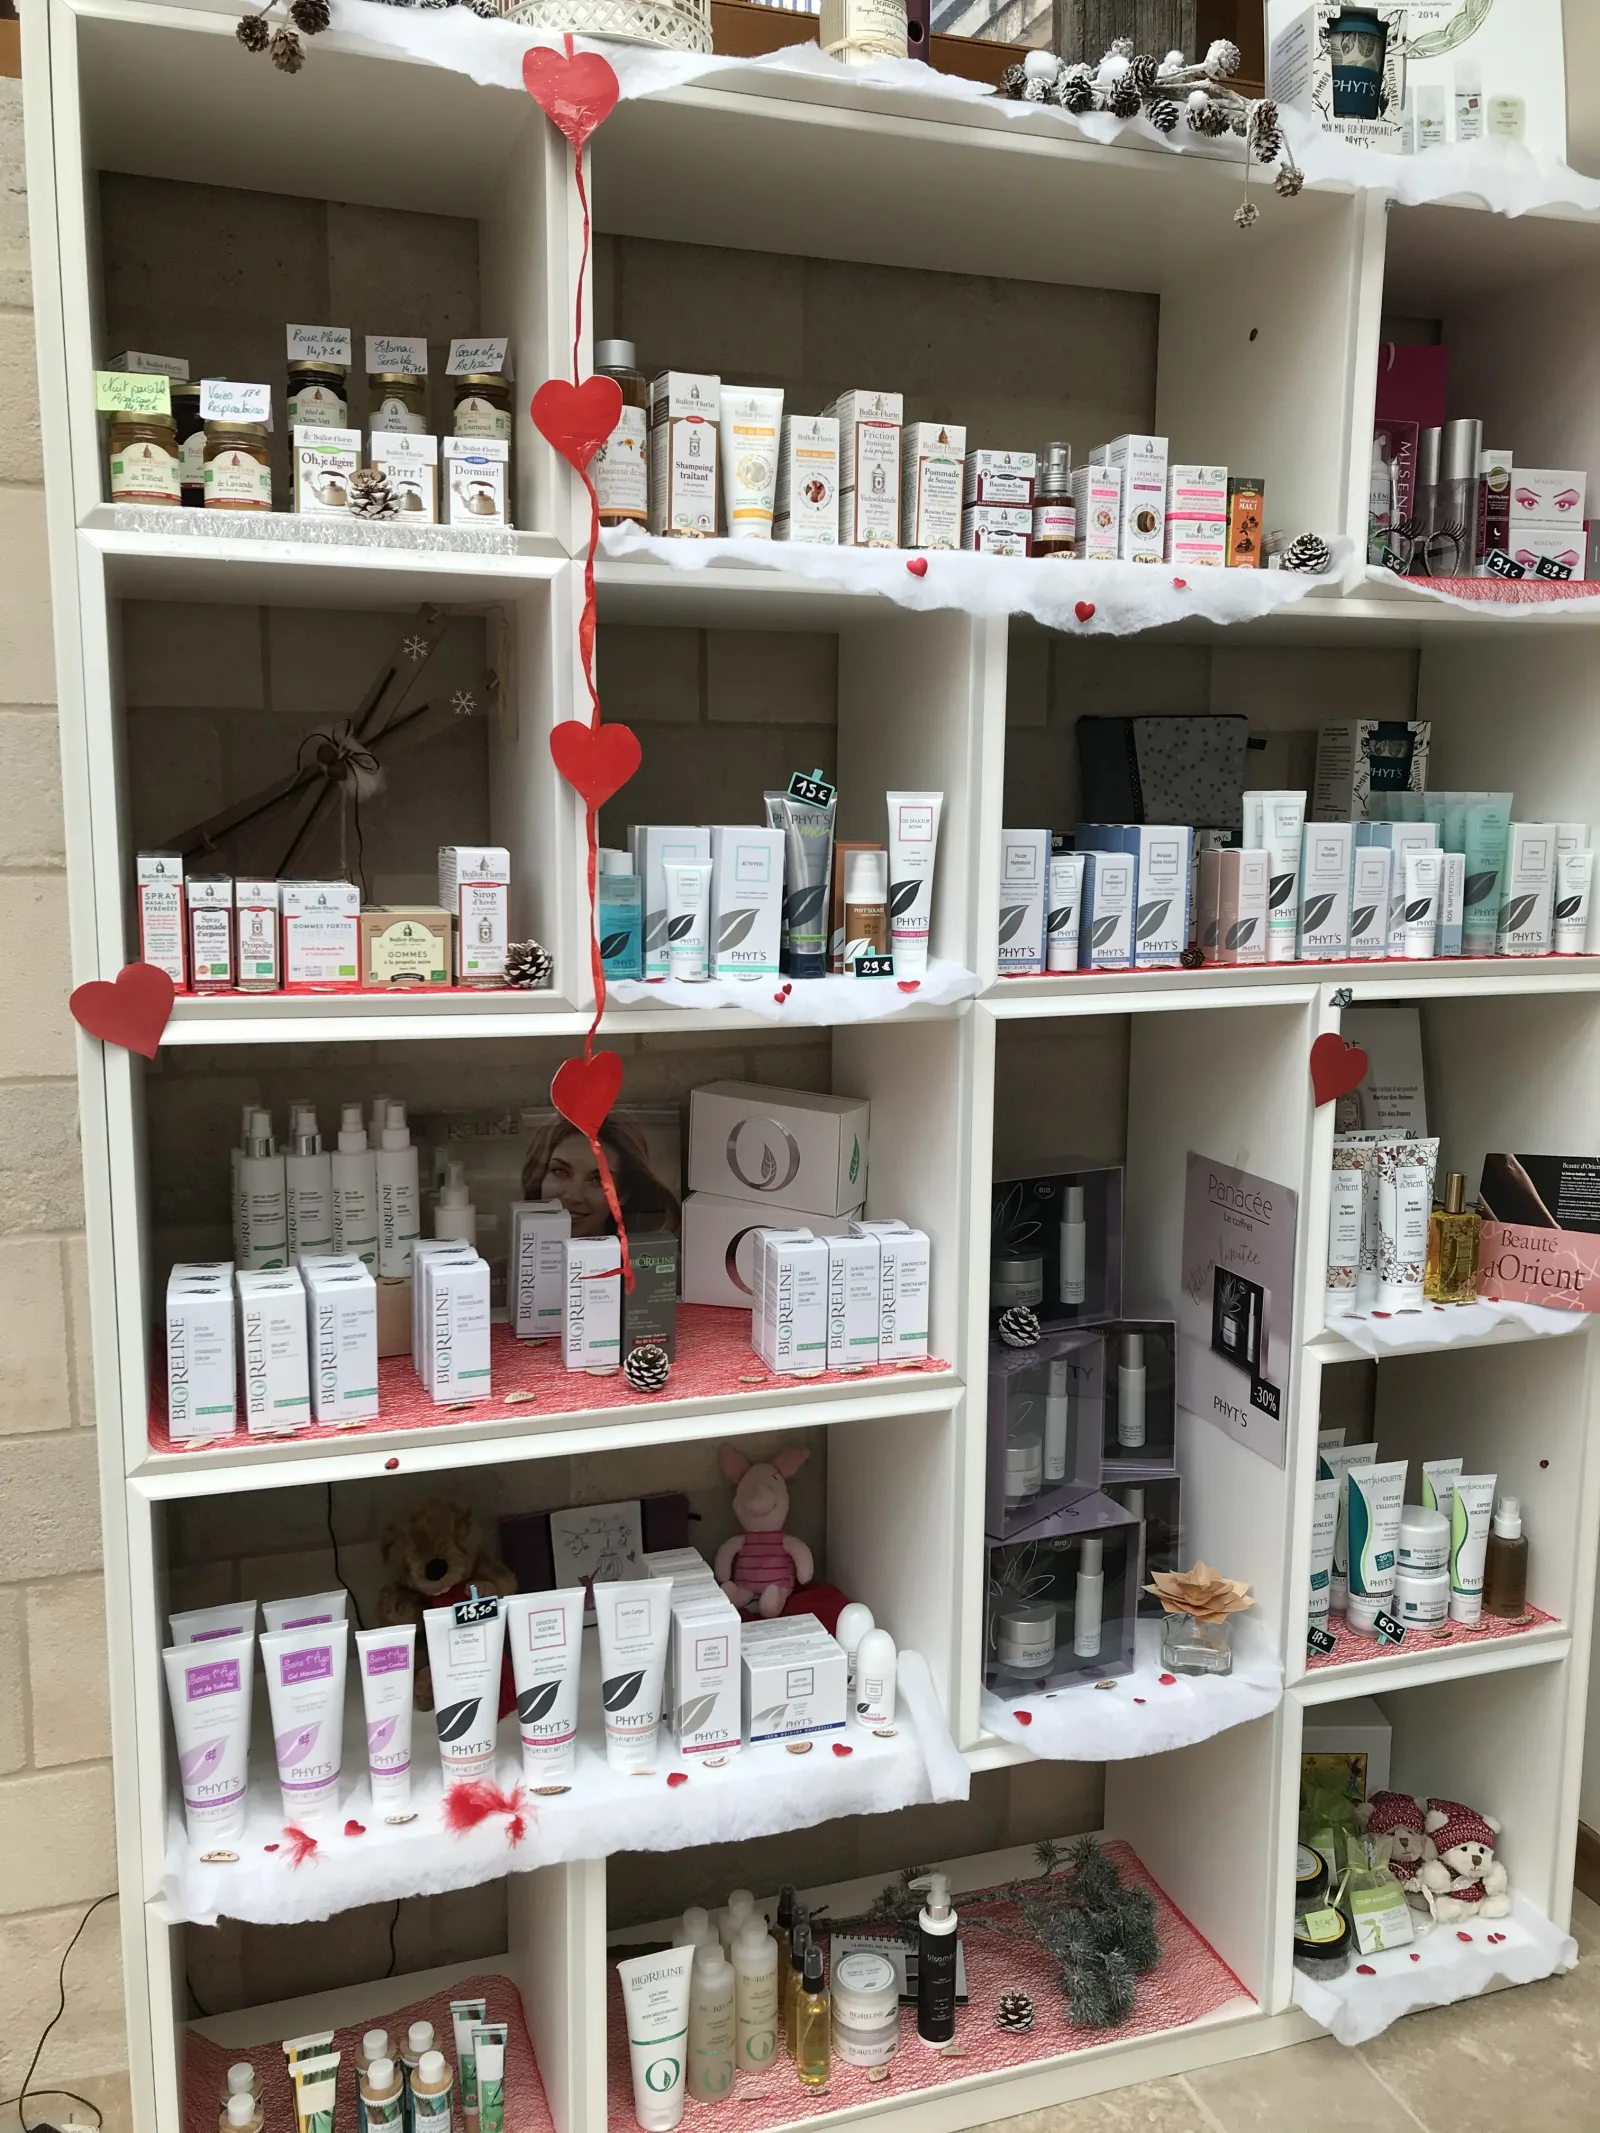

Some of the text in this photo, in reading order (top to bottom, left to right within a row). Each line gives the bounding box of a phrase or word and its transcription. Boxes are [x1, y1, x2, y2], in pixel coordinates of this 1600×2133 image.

[1332, 79, 1376, 97] PHYT'S
[1321, 123, 1333, 132] MON
[1335, 124, 1345, 133] MUG
[675, 397, 715, 409] Ballot-Flurin
[859, 408, 899, 419] Ballot-Flurin
[863, 430, 895, 440] Friction
[866, 440, 892, 449] tonique
[873, 448, 894, 456] propolis
[329, 455, 354, 469] digère
[675, 461, 714, 473] Shampoing
[387, 465, 416, 477] Brrr
[680, 471, 709, 481] traitant
[924, 468, 960, 478] Pommade
[225, 479, 253, 490] Lavande
[935, 477, 957, 485] Secours
[1370, 766, 1403, 779] PHYT'S
[791, 813, 831, 825] PHYT'S
[462, 870, 506, 879] Ballot-Flurin
[1448, 860, 1456, 907] IMPERFECTIONS
[145, 892, 177, 900] SPRAY
[472, 890, 497, 899] Sirop
[473, 898, 497, 906] d'hiver
[146, 904, 178, 912] PYRÉNÉES
[201, 916, 220, 925] Spray
[896, 916, 928, 926] PHYT'S
[196, 923, 227, 931] nomade
[197, 930, 226, 939] d'urgence
[1308, 934, 1341, 945] PHYT'S
[1512, 931, 1542, 942] PHYT'S
[241, 941, 273, 950] Propolis
[1143, 941, 1178, 951] PHYT'S
[1355, 937, 1380, 945] PHYT'S
[999, 946, 1035, 958] PHYT'S
[1097, 948, 1125, 957] PHYT'S
[1242, 944, 1261, 952] PHYT'S
[732, 950, 767, 960] PHYT'S
[1400, 1180, 1423, 1188] d'Orient
[1038, 1186, 1051, 1194] BIO
[1208, 1173, 1273, 1221] Panacée
[383, 1184, 394, 1249] BIORELINE
[1224, 1212, 1253, 1232] Le coffret
[1501, 1230, 1558, 1253] Beauté
[520, 1232, 535, 1320] BIORELINE
[1484, 1254, 1585, 1291] d'Orient
[830, 1259, 846, 1350] BIORELINE
[882, 1254, 897, 1345] BIORELINE
[778, 1263, 794, 1356] BIORELINE
[436, 1287, 452, 1385] BIORELINE
[320, 1304, 338, 1406] BIORELINE
[247, 1310, 267, 1413] BIORELINE
[170, 1317, 189, 1421] BIORELINE
[1253, 1386, 1278, 1413] -30%
[1213, 1396, 1248, 1428] PHYT'S
[1054, 1539, 1067, 1547] BIO
[1370, 1578, 1393, 1587] PHYT'S
[1462, 1576, 1484, 1585] PHYT'S
[283, 1657, 304, 1671] Soins
[368, 1653, 386, 1664] Soins
[188, 1673, 211, 1685] Soins
[192, 1688, 204, 1696] Lait
[615, 1711, 654, 1726] PHYT'S
[786, 1717, 813, 1728] PHYT'S
[533, 1719, 570, 1734] PHYT'S
[694, 1729, 729, 1742] PHYT'S
[452, 1740, 492, 1756] PHYT'S
[374, 1749, 409, 1764] PHYT'S
[292, 1761, 332, 1778] PHYT'S
[197, 1776, 240, 1796] PHYT'S
[631, 1966, 684, 1987] BIORELINE
